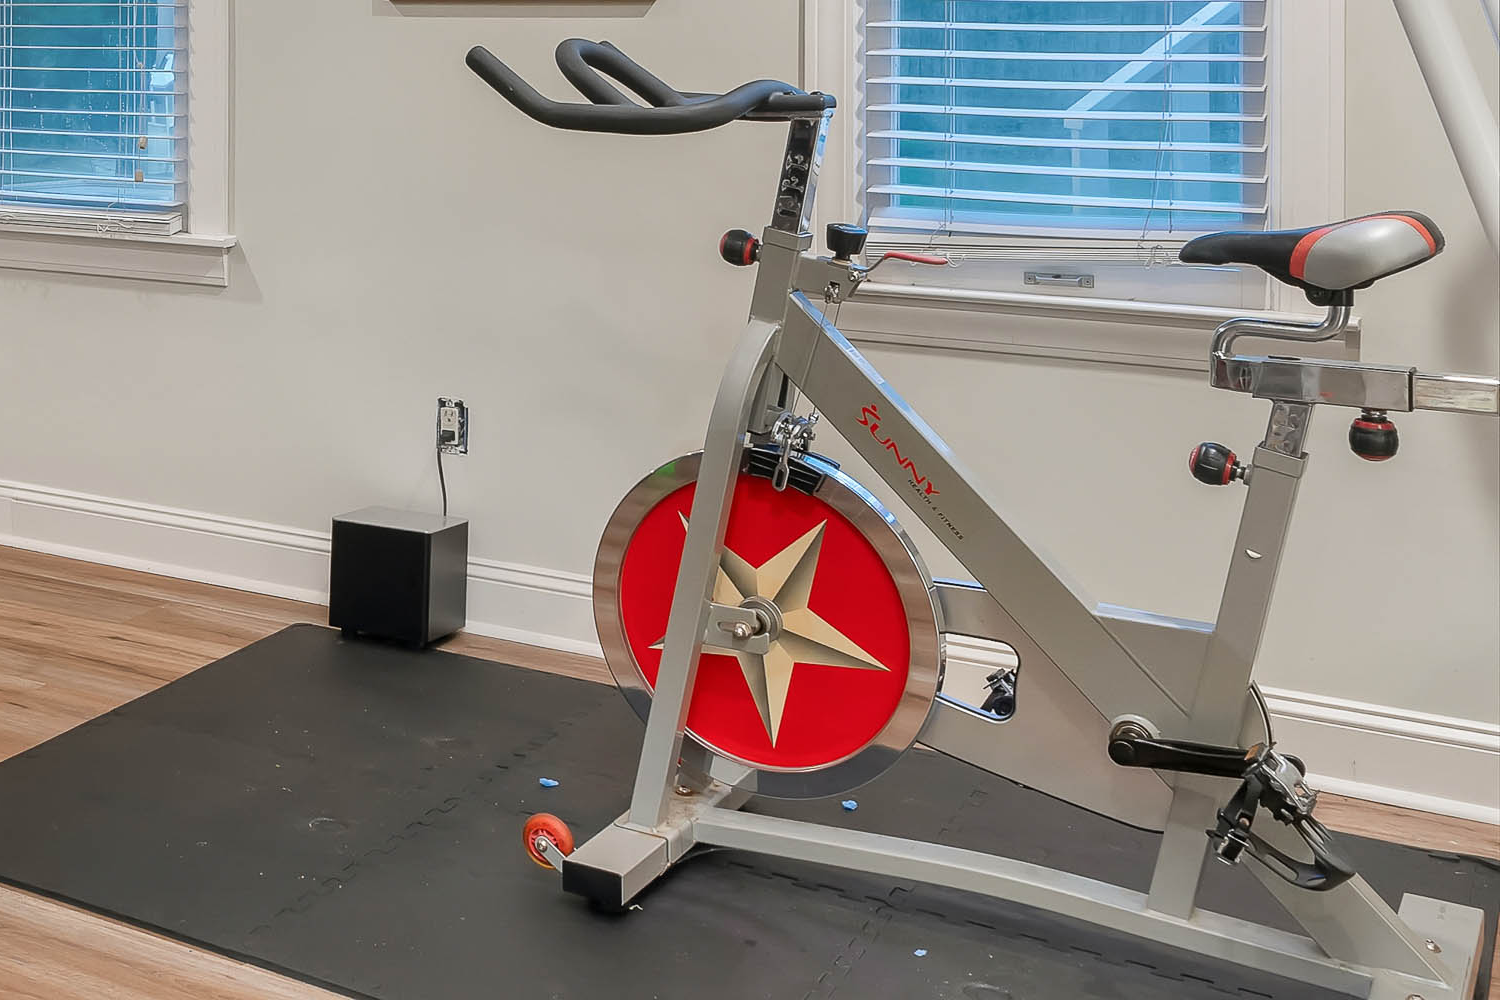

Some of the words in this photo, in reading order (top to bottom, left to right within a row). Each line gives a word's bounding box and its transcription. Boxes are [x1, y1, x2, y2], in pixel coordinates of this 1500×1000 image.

[855, 404, 941, 495] SUNNY
[908, 479, 931, 504] HEALTH
[938, 512, 964, 540] FITNESS
